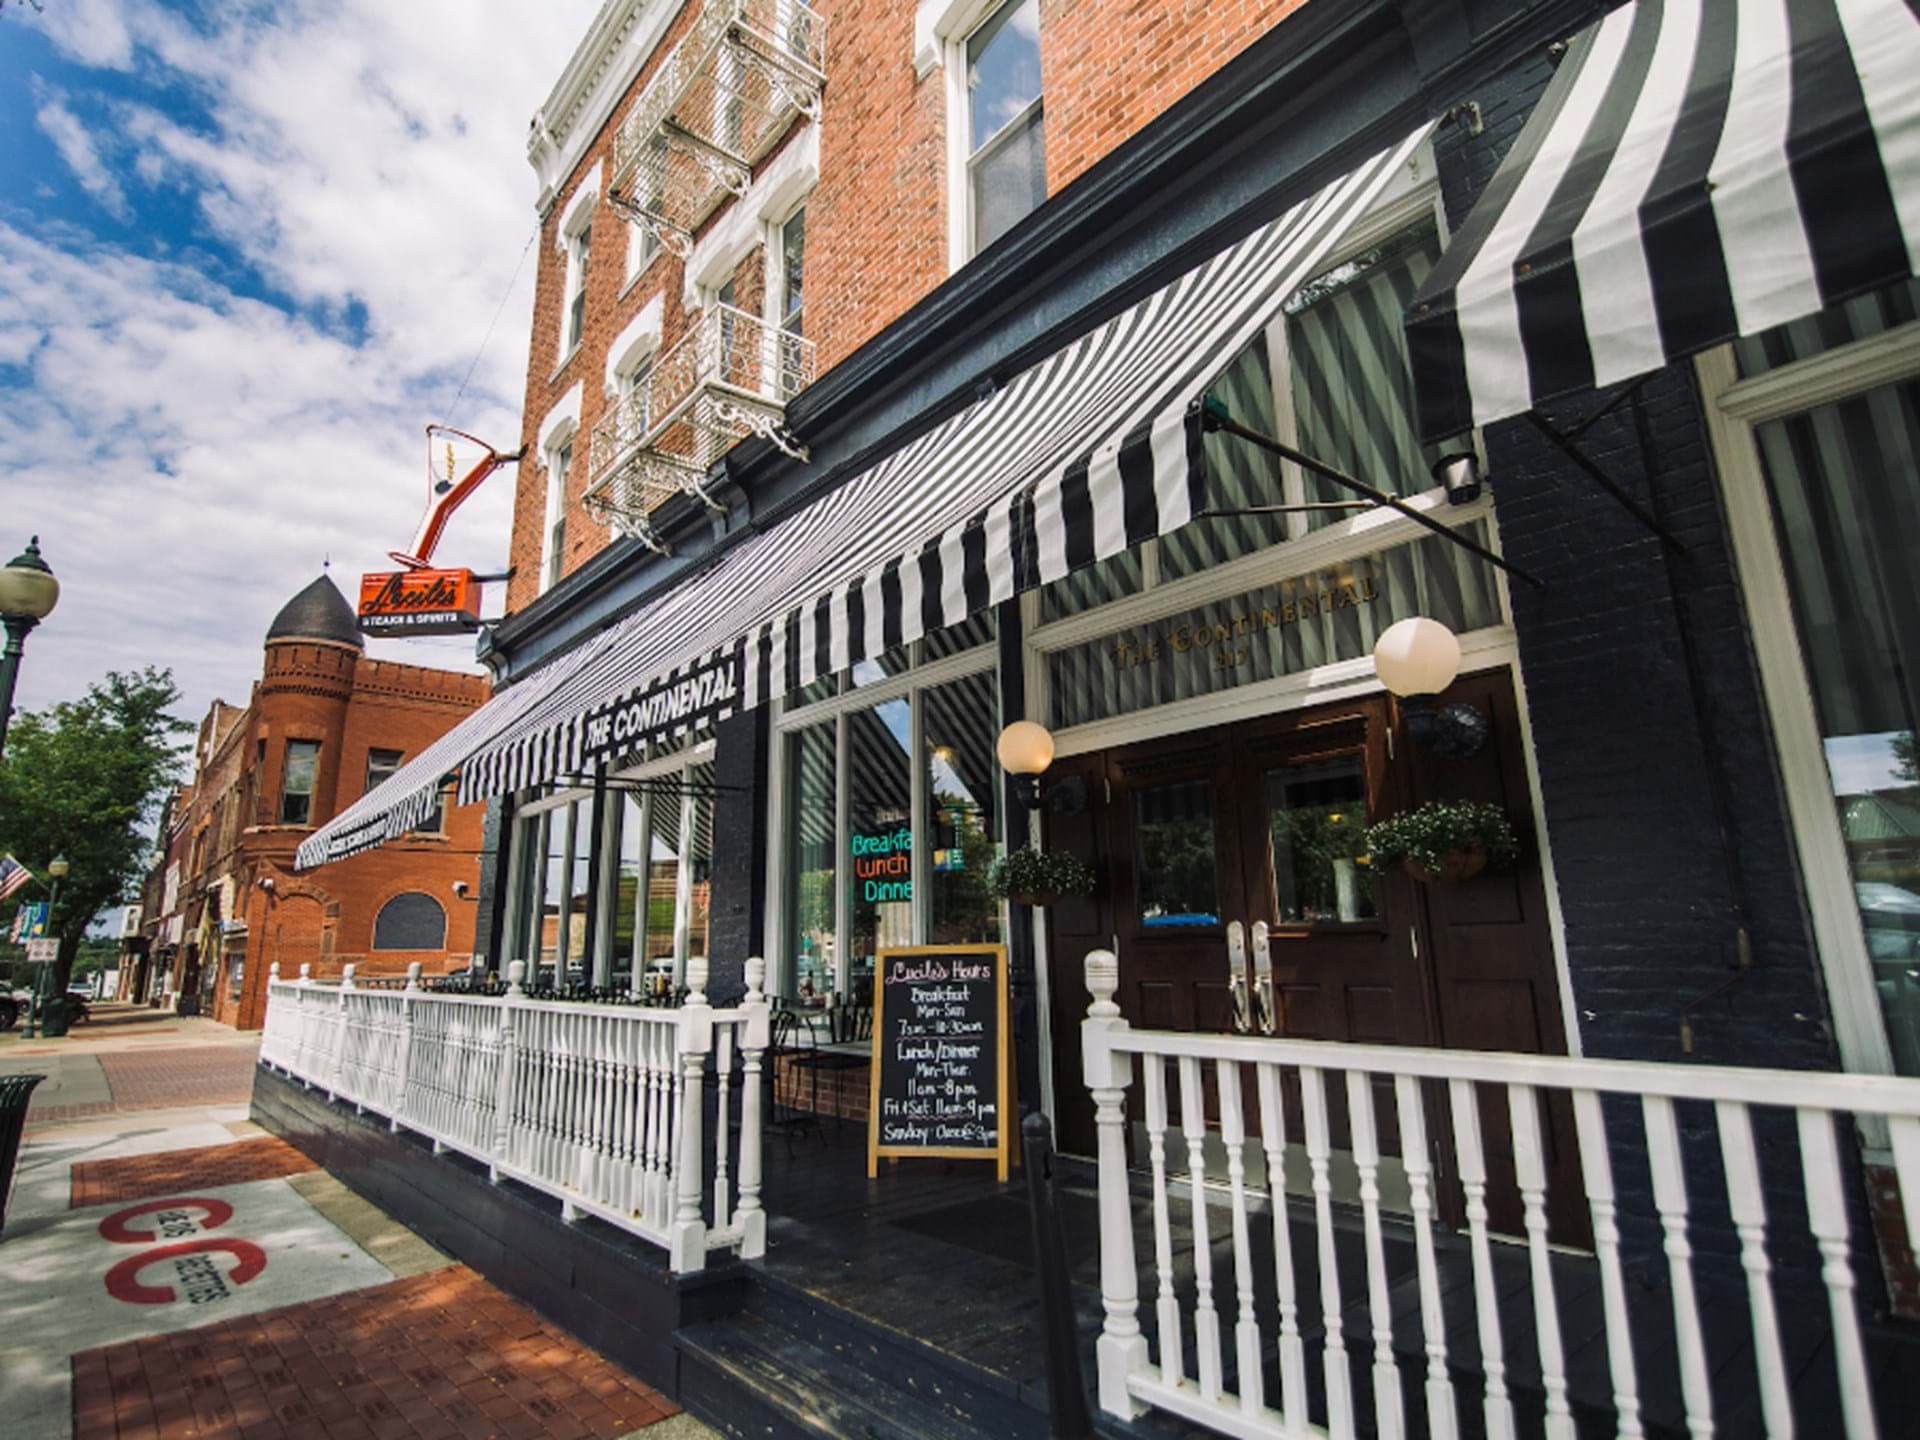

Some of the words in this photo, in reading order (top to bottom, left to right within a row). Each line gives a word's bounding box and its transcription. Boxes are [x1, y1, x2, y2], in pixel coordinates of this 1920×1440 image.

[362, 615, 404, 626] STEAKS
[416, 612, 457, 624] SPIRITS
[1112, 639, 1160, 671] THE
[1167, 577, 1379, 653] CONTINENTAL
[584, 713, 612, 750] THE
[613, 660, 736, 741] CONTINENTAL
[851, 827, 912, 856] Breakfa
[856, 852, 909, 878] Lunch
[864, 880, 912, 902] Dinne
[951, 960, 991, 981] Hours
[910, 984, 971, 1003] Breakfast
